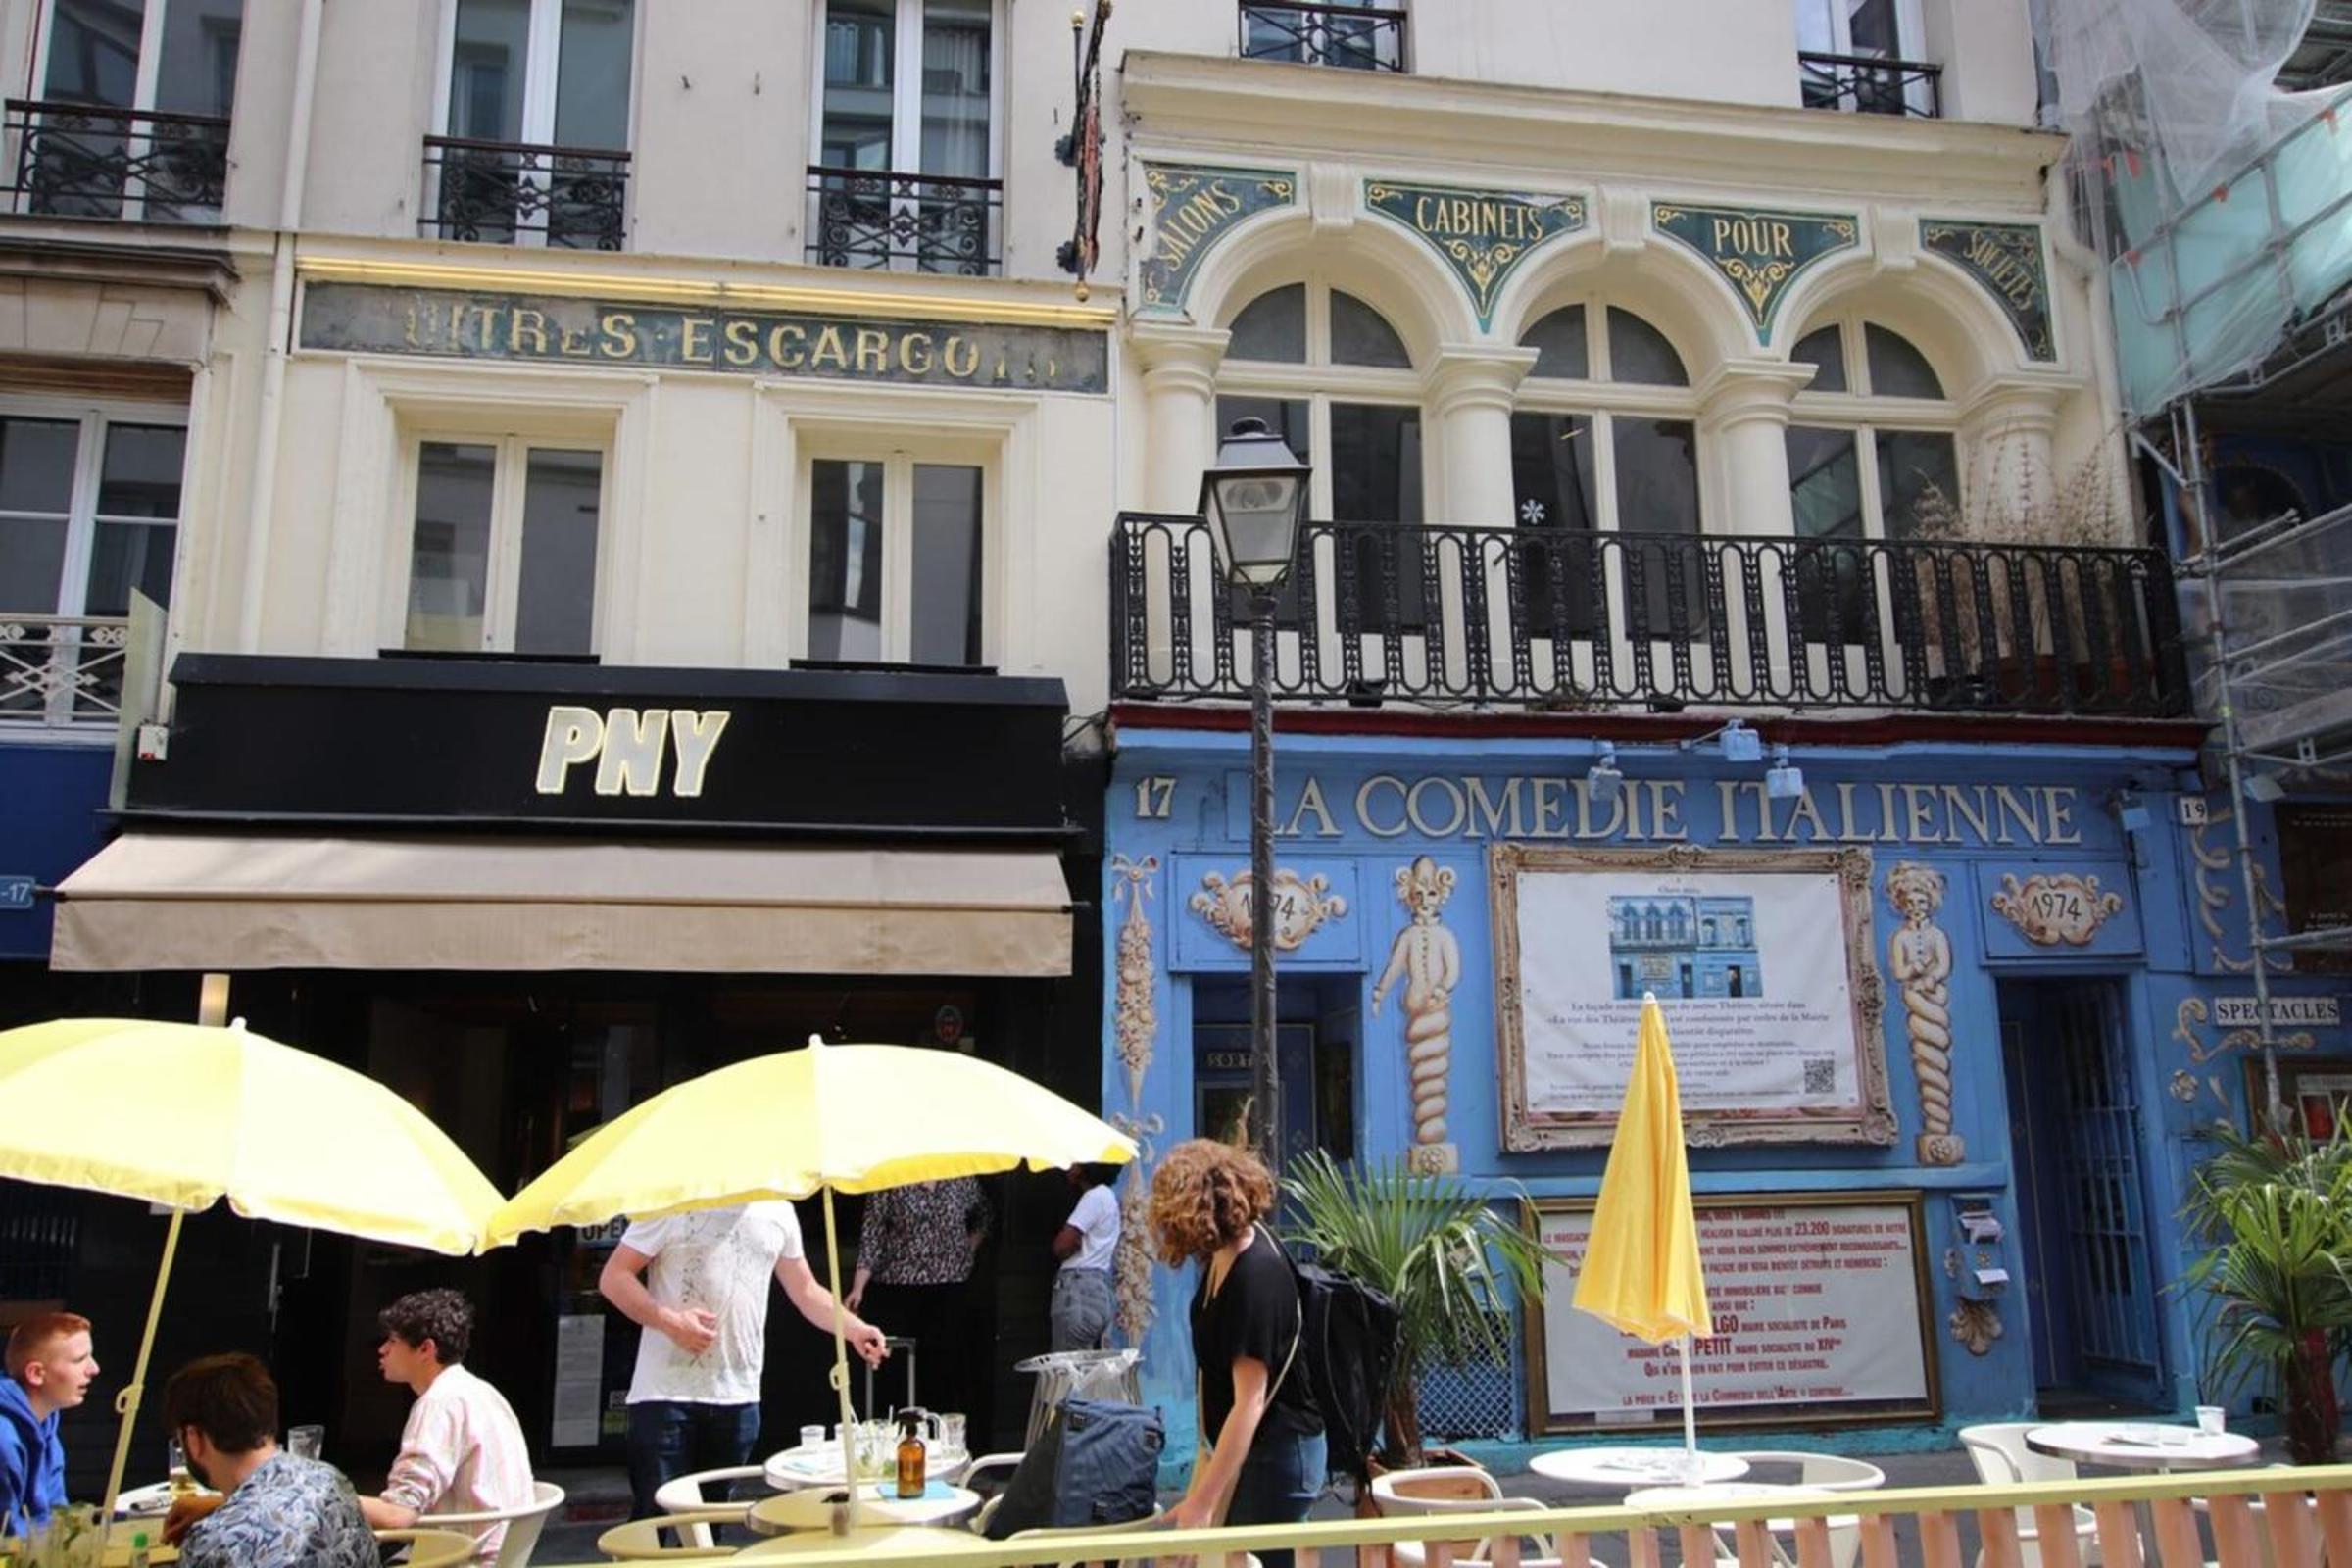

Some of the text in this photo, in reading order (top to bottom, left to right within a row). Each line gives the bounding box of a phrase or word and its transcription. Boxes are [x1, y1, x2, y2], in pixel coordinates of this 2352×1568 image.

[1157, 178, 1241, 271] SALONS
[1415, 195, 1544, 241] CABINETS
[1714, 218, 1793, 258] POUR
[536, 706, 731, 796] PNY
[1136, 777, 1176, 817] 17
[1355, 776, 1688, 840] COMEDIE
[1717, 781, 2082, 845] ITALIENNE
[2183, 802, 2205, 819] 19
[2031, 893, 2082, 921] 1974
[1694, 1338, 1733, 1356] PETIT
